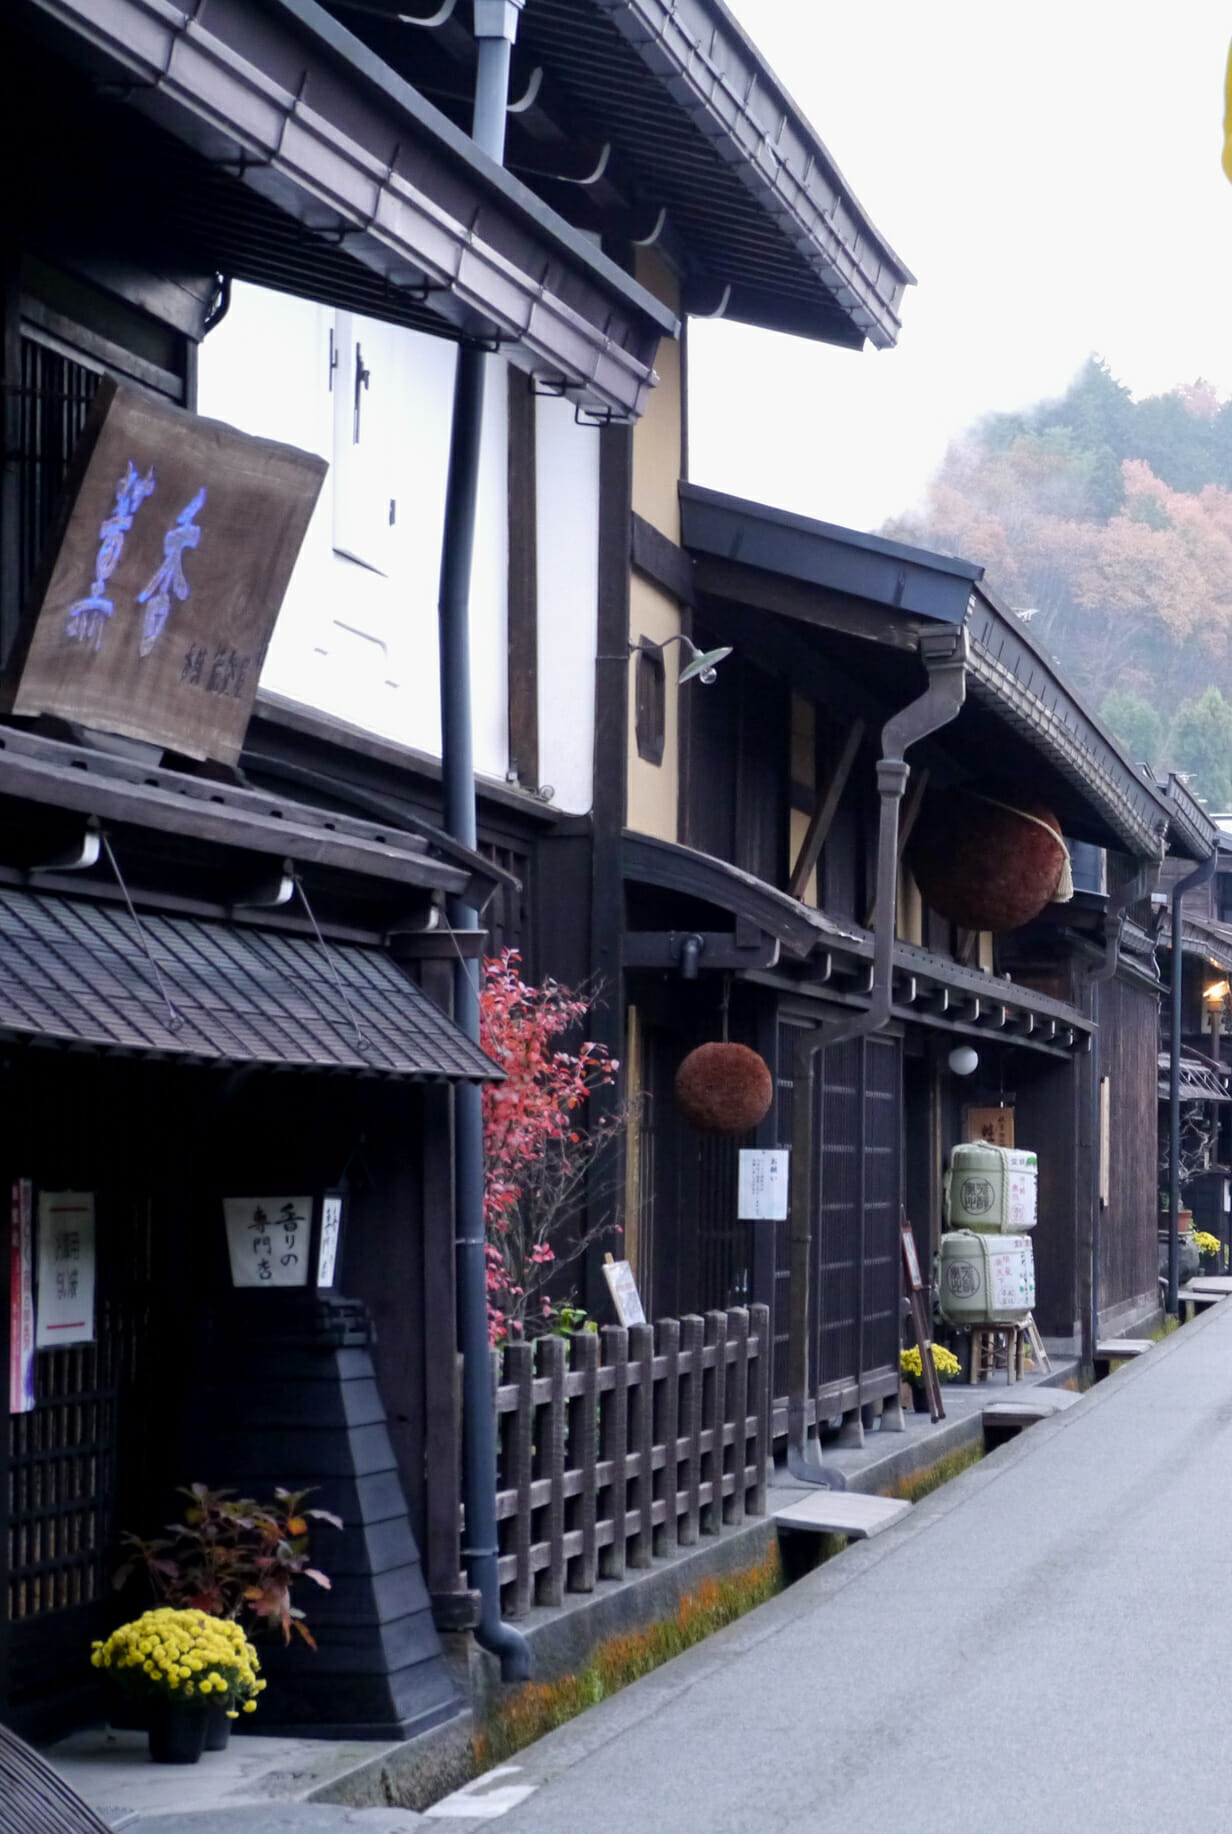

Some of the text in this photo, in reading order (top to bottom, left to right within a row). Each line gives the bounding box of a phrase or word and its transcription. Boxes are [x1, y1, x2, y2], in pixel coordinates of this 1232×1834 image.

[248, 1204, 273, 1280] 専門店
[275, 1203, 305, 1267] 香りの
